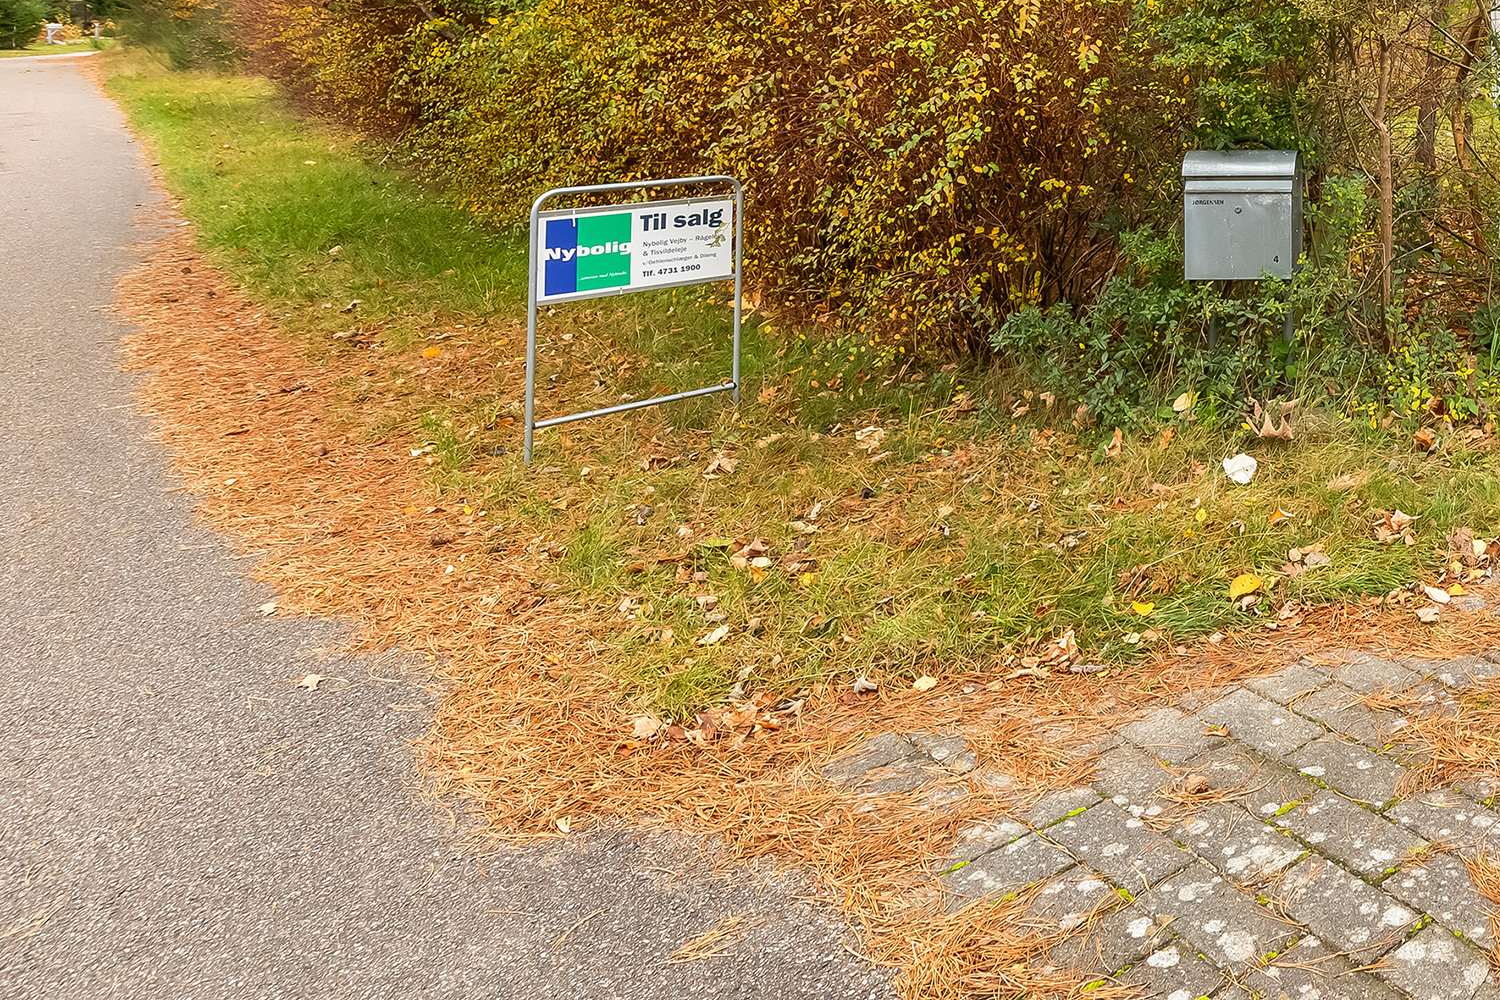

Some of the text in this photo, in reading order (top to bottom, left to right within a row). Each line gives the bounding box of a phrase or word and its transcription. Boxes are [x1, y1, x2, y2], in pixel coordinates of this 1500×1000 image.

[640, 208, 723, 231] Til salg
[643, 239, 668, 248] Nybolig
[544, 241, 632, 262] Nybolig
[651, 247, 687, 255] Tisvildeleje
[1273, 255, 1279, 263] 4
[658, 267, 678, 275] 4731
[681, 264, 701, 272] 1900
